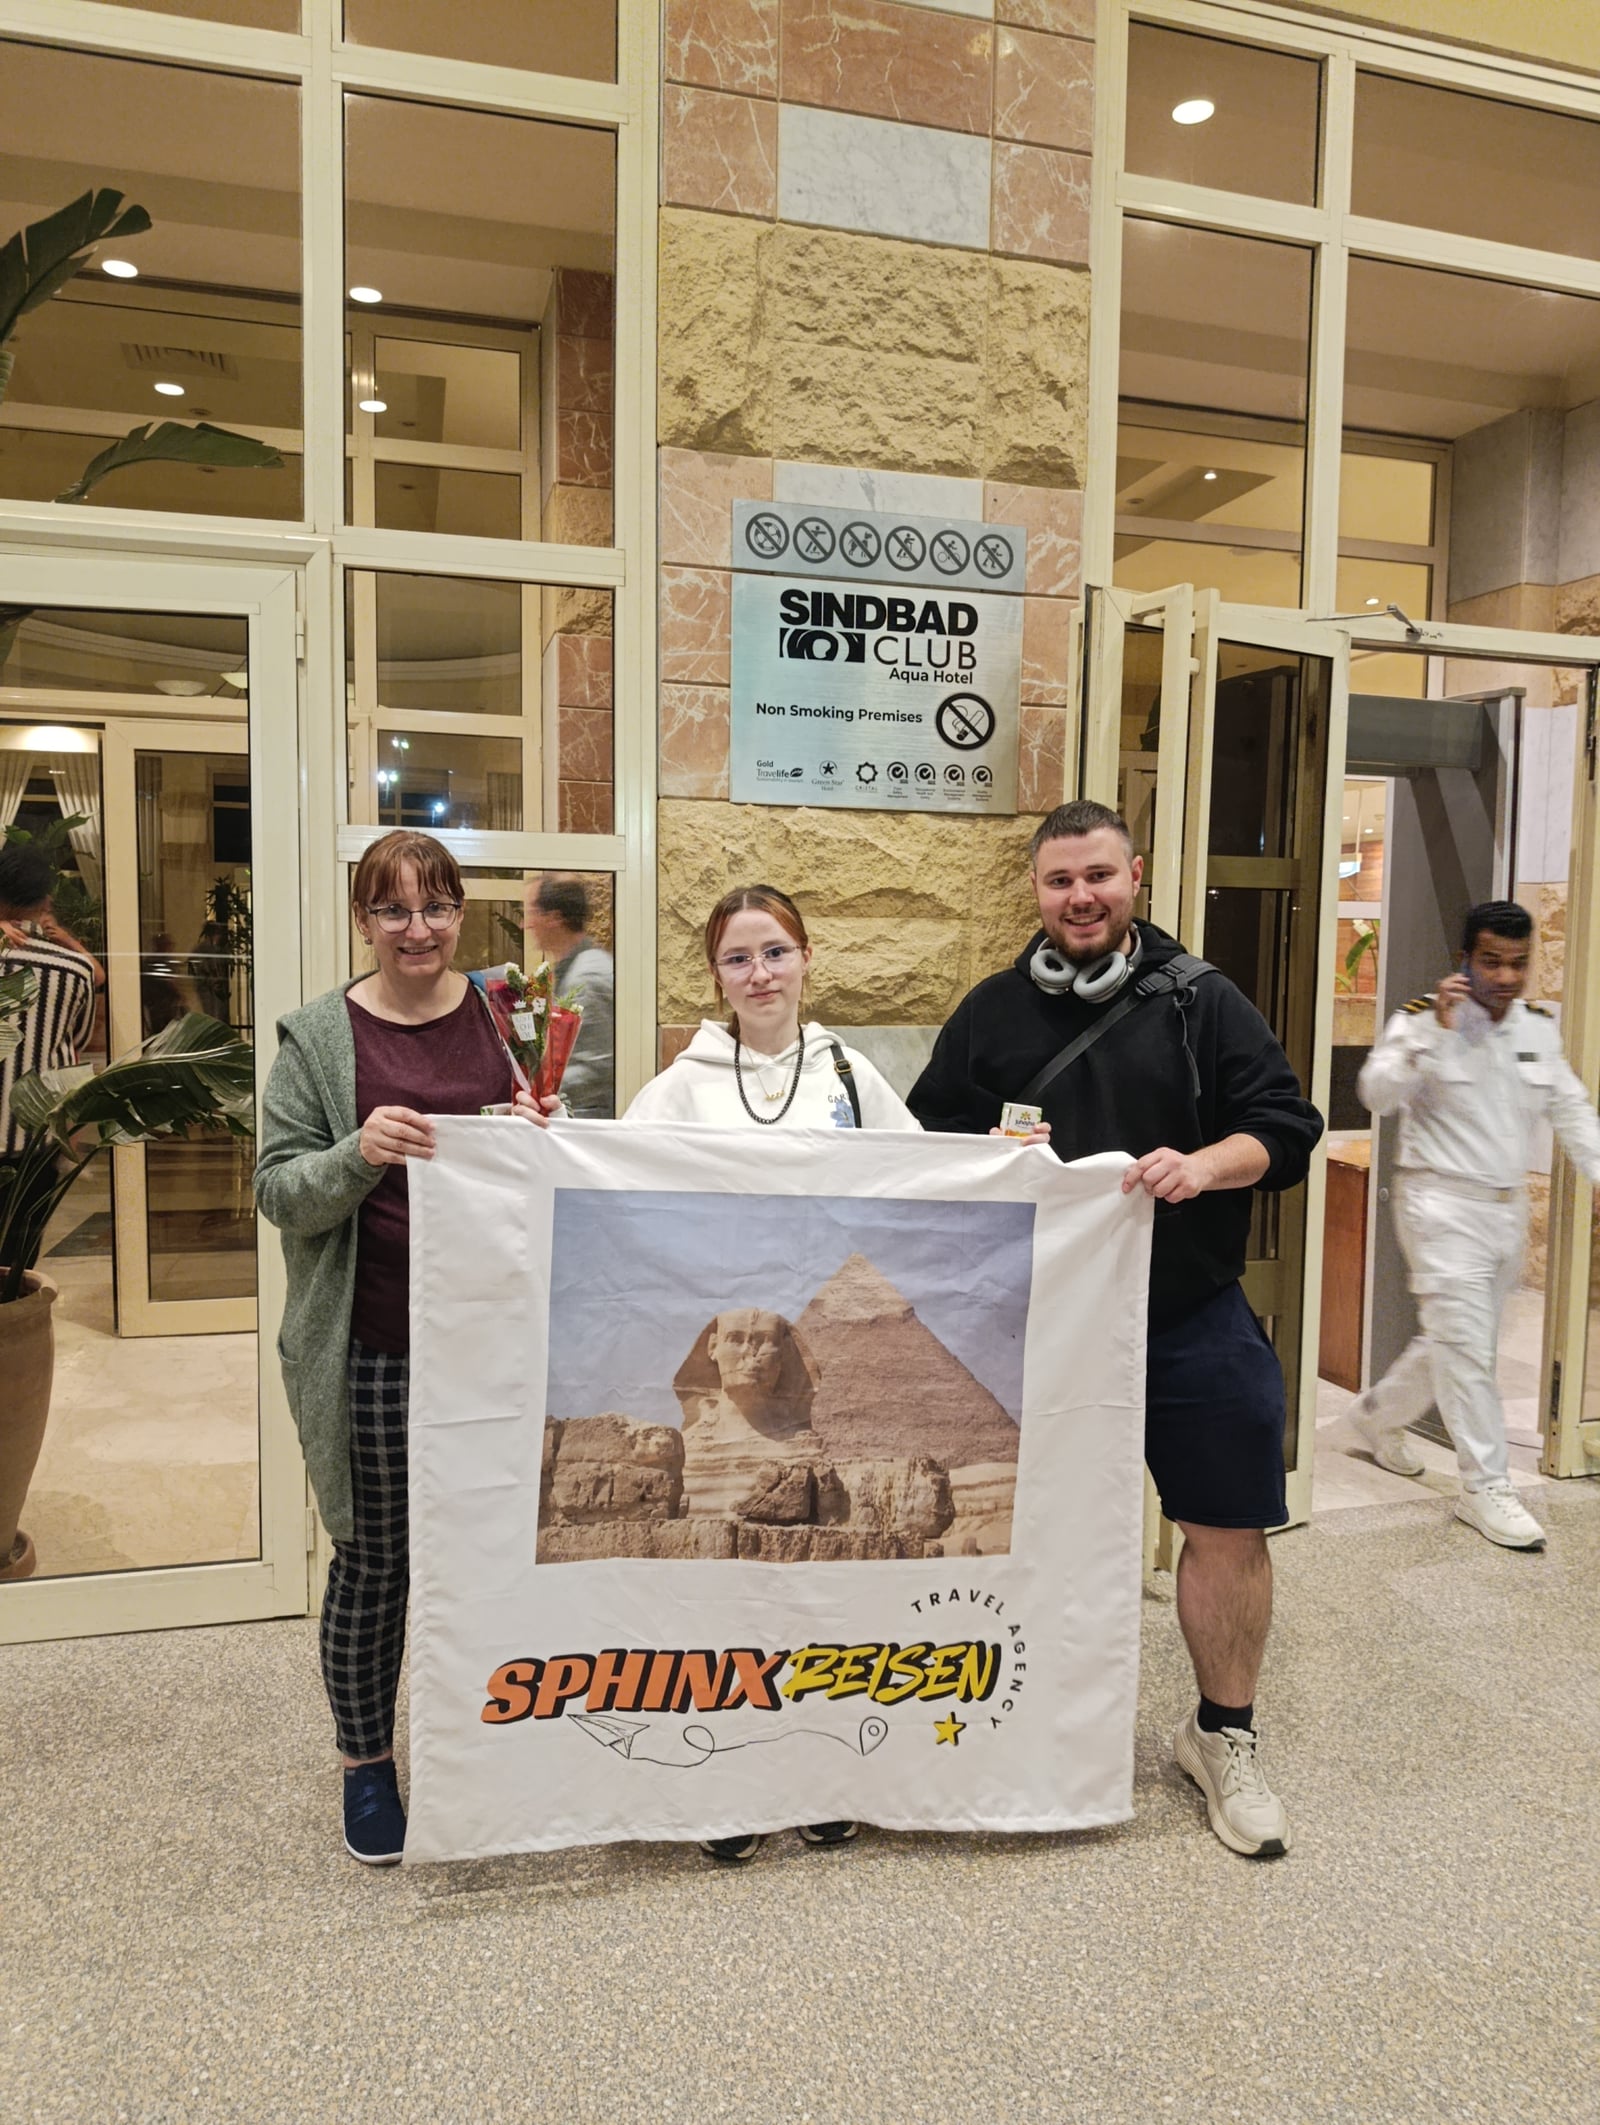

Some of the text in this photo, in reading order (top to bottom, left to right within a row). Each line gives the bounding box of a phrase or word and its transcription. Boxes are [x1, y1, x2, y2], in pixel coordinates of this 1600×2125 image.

[779, 588, 979, 637] SINDBAD
[873, 636, 977, 670] CLUB
[889, 667, 973, 685] Aqua Hotel
[755, 702, 923, 723] Non Smoking Premises
[756, 760, 774, 768] Gold
[911, 1588, 1027, 1729] TRAVEL AGENCY
[481, 1641, 1002, 1724] SPHINX REISEN
